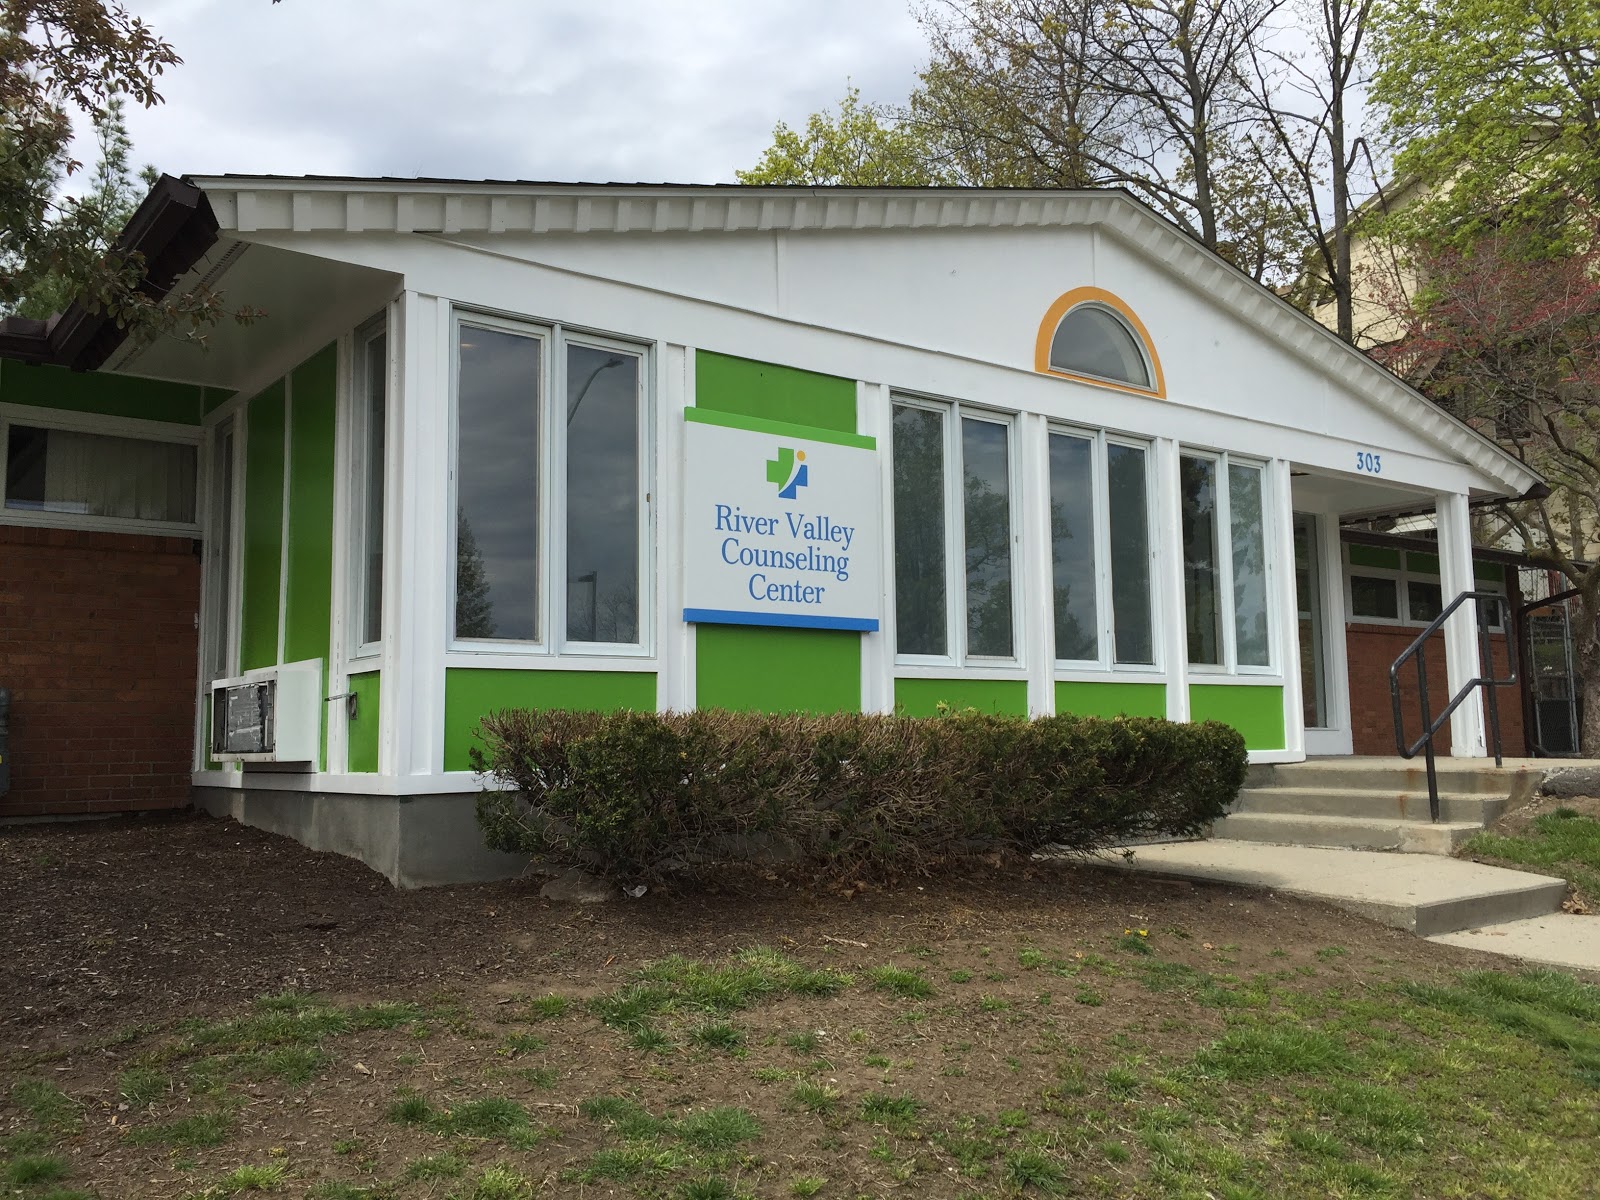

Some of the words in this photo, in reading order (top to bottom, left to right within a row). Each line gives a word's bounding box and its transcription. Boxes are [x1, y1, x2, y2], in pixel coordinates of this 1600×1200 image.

[1356, 451, 1381, 474] 303
[714, 504, 779, 536] River
[785, 512, 855, 551] Valley
[721, 537, 849, 582] Counseling
[748, 573, 826, 604] Center
